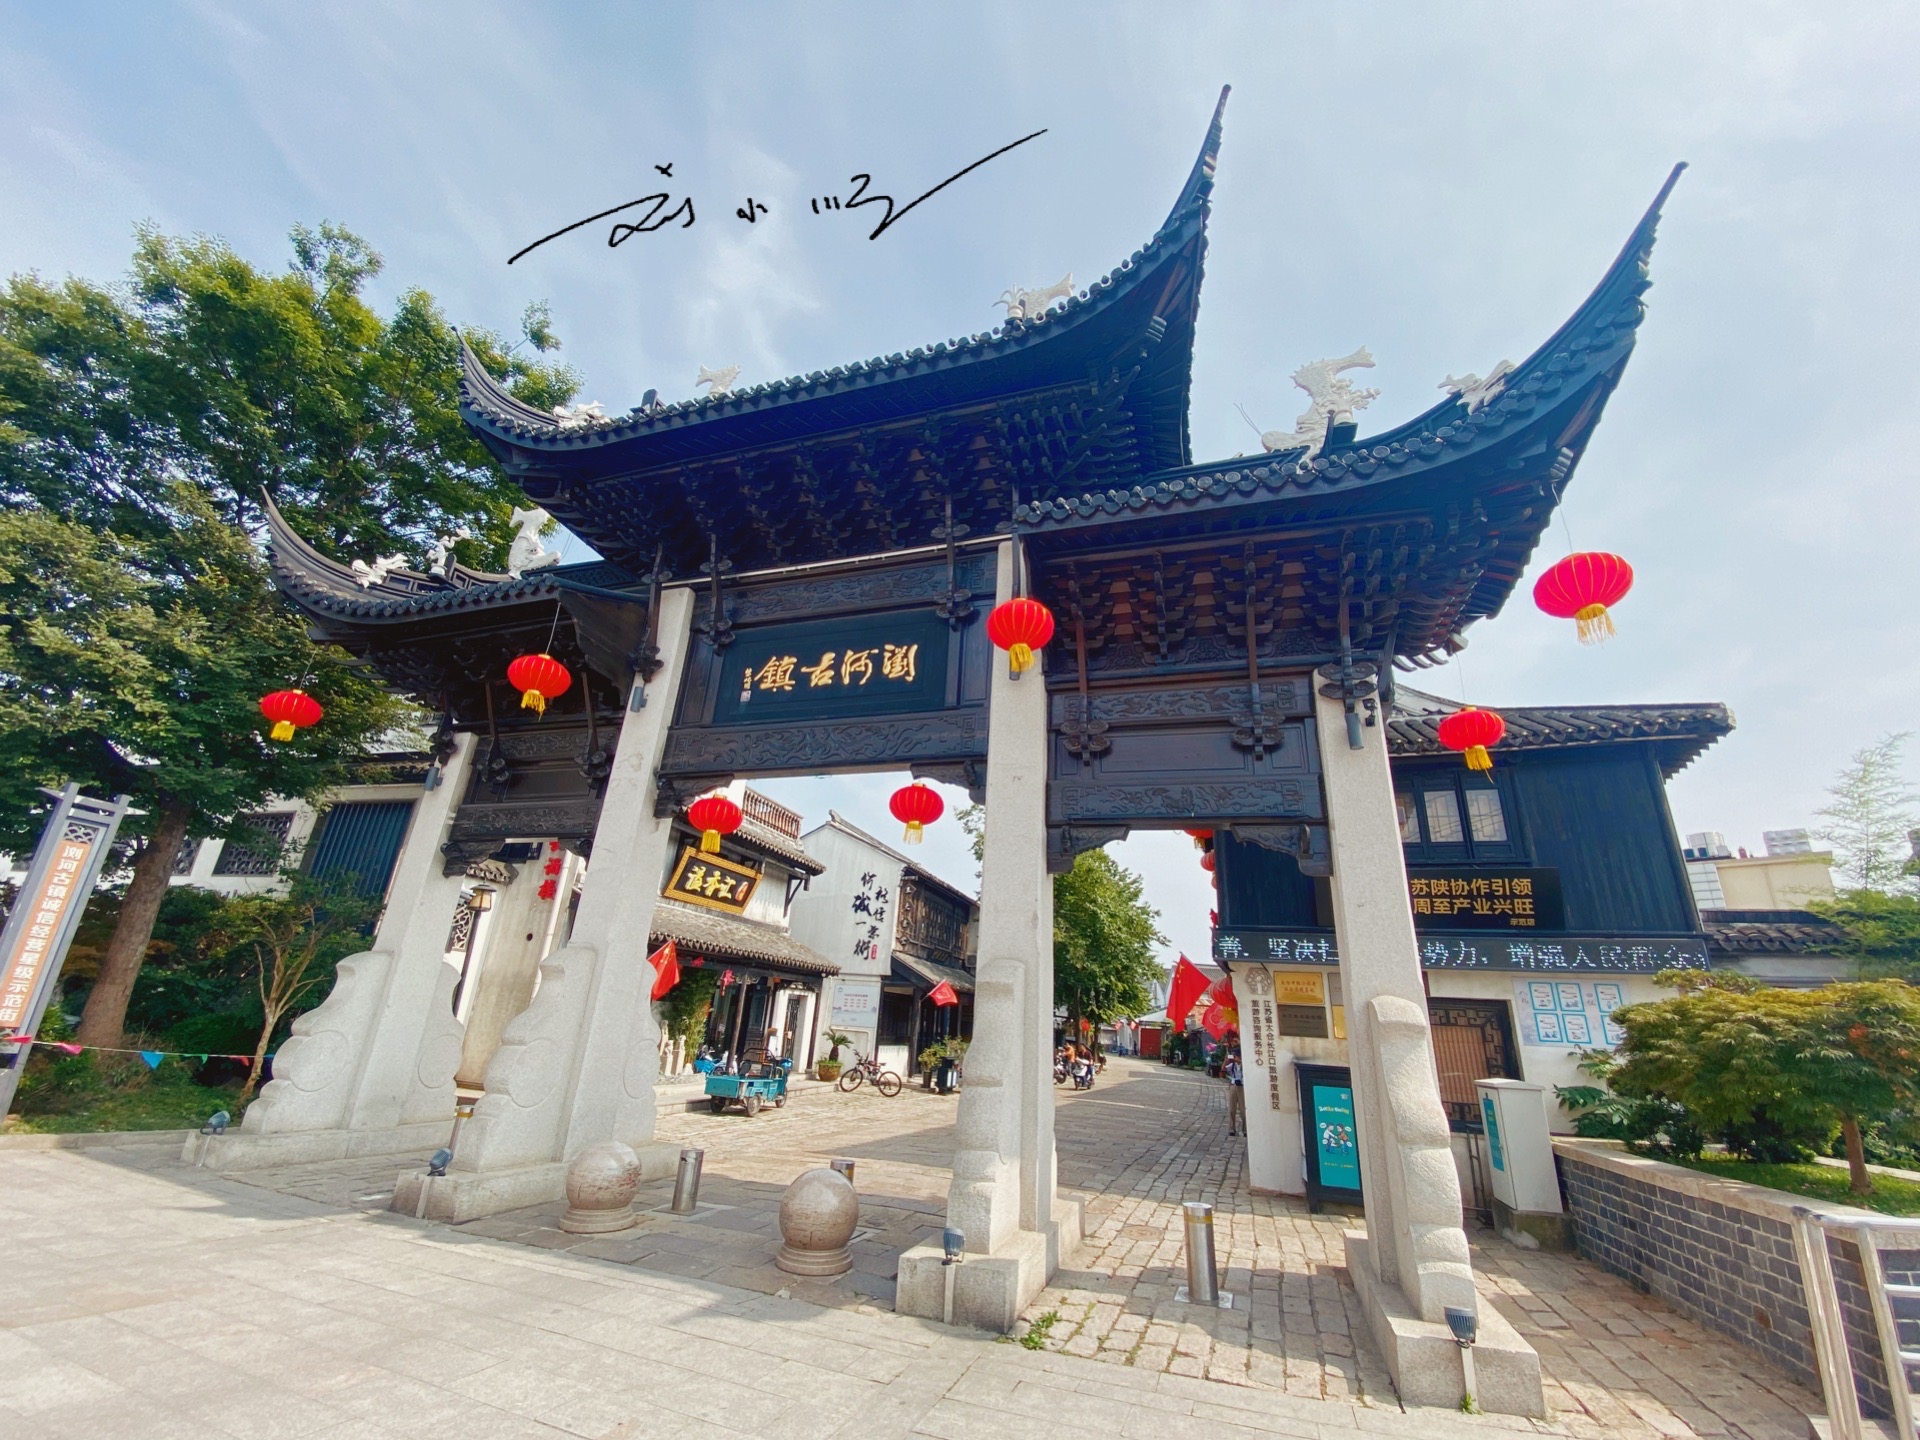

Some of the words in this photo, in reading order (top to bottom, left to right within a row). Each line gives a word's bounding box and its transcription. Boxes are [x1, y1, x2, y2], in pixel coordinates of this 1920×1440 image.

[1411, 878, 1533, 896] 苏陕协作引领
[1413, 898, 1535, 915] 周至产业兴旺
[0, 845, 84, 1022] 浏河古镇诚信经营星级示范街
